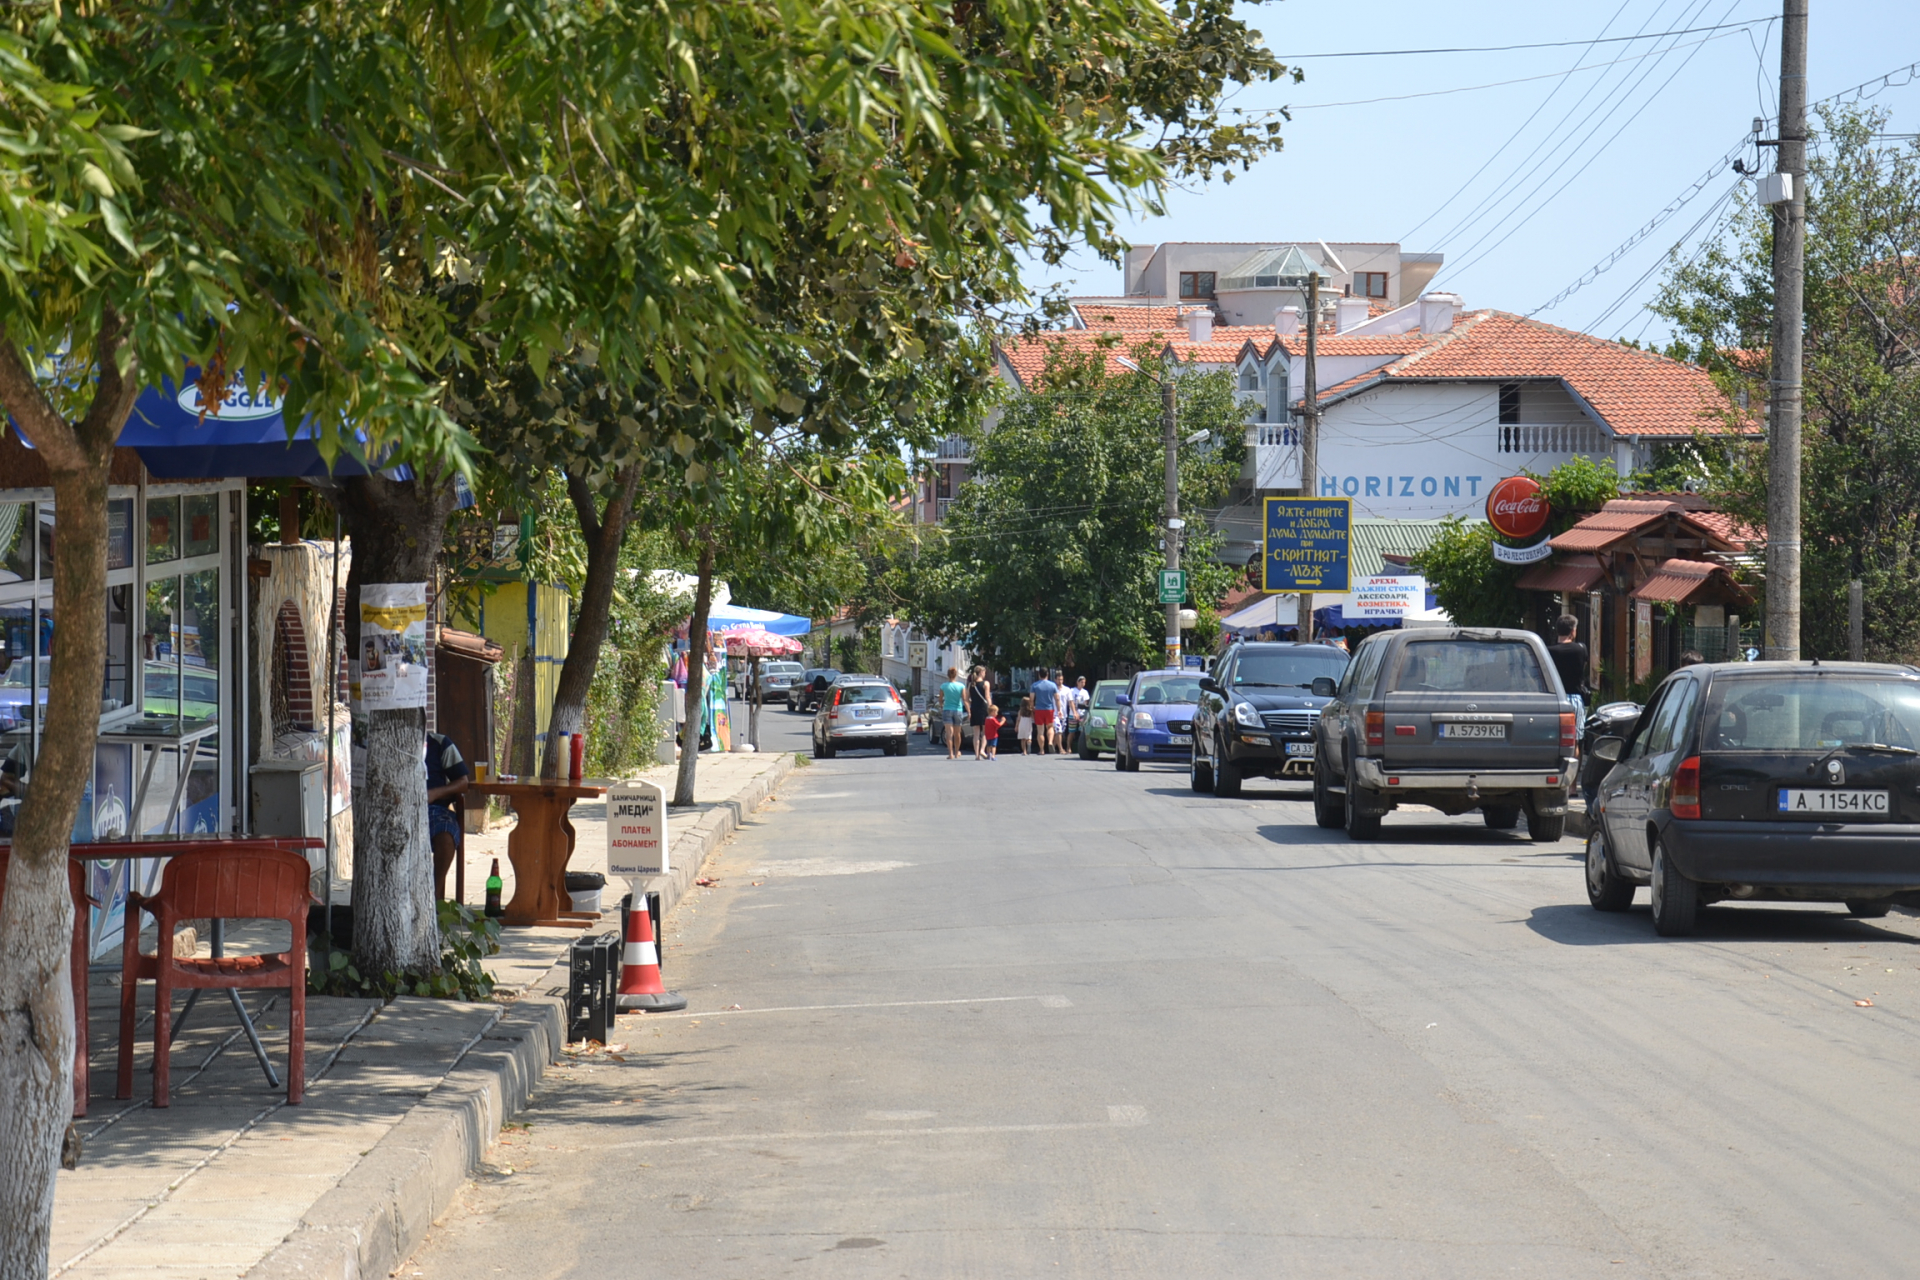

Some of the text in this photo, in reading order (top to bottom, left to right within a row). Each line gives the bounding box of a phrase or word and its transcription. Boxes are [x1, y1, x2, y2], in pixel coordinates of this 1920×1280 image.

[1321, 476, 1482, 497] HORIZONT
[1268, 528, 1347, 540] ДУМА ДУМАЙТЕ
[621, 826, 651, 834] ПЛАТЕН
[612, 840, 658, 848] АБОНАМЕНТ
[611, 865, 660, 874] Община Царево
